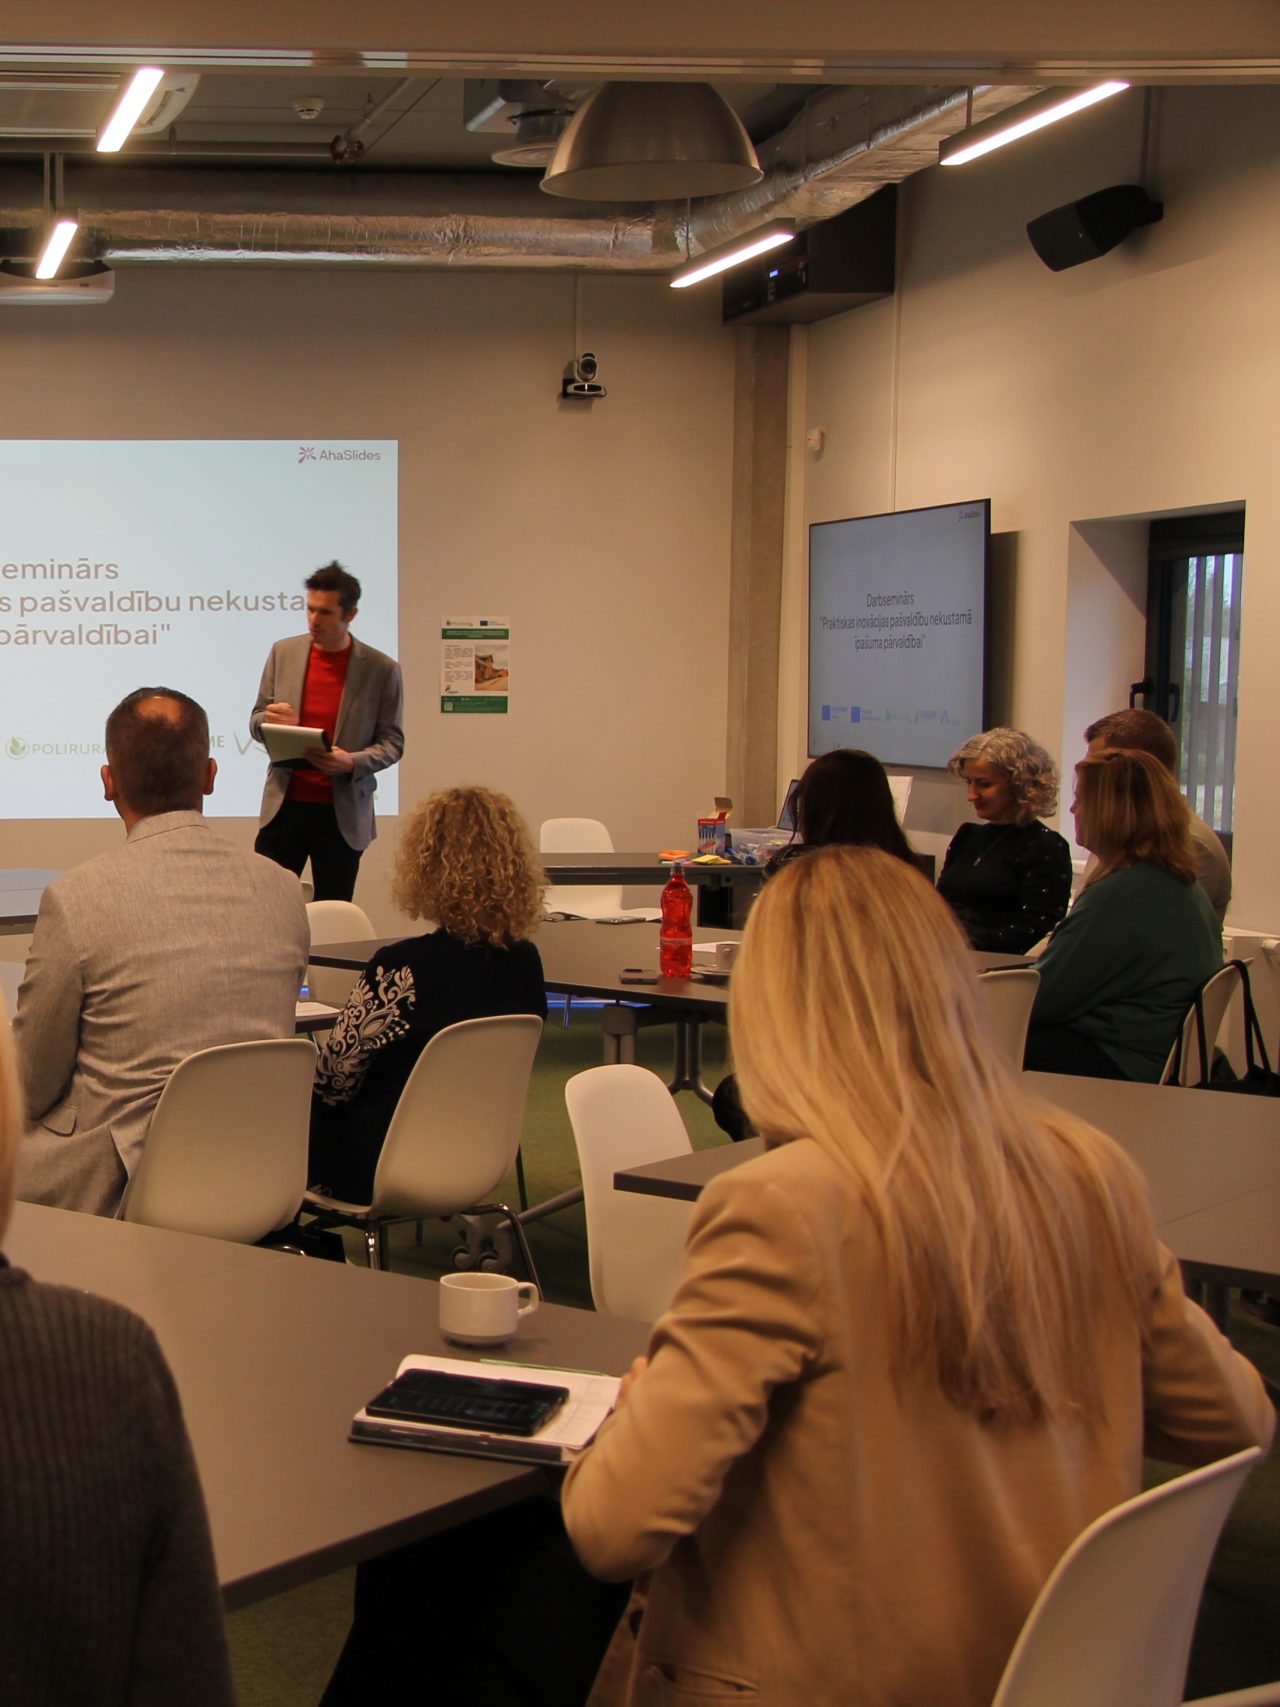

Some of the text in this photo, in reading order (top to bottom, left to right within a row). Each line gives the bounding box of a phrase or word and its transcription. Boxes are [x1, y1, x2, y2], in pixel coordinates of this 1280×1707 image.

[320, 449, 381, 461] AhaSlides
[19, 589, 181, 618] pašvaldību
[188, 589, 306, 612] nekusta
[866, 589, 914, 608] Darbseminārs
[929, 608, 971, 627] nekustamā
